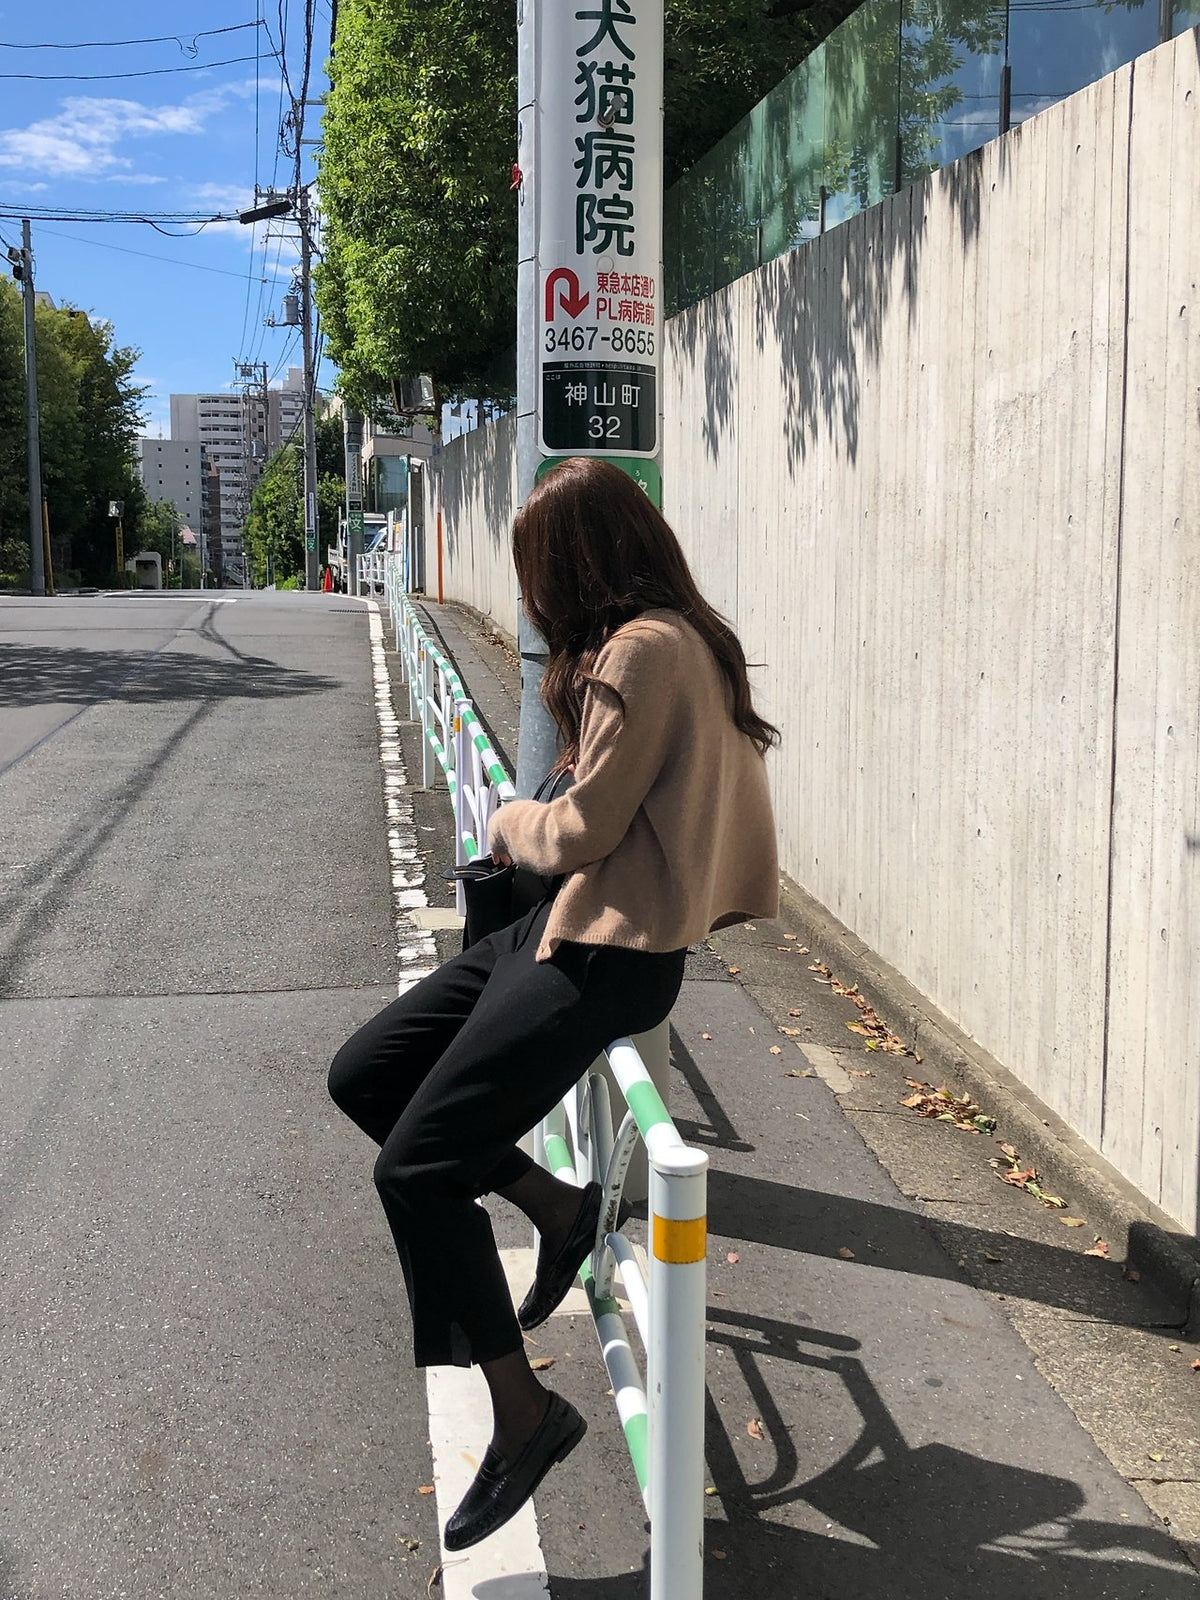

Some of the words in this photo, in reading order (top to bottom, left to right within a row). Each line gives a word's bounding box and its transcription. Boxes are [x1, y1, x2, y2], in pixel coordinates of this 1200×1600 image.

[574, 0, 636, 257] 犬猫病院
[596, 271, 655, 299] 東急本店通り
[596, 297, 655, 326] PL病院前
[545, 326, 655, 357] 3467-8655
[564, 381, 641, 408] 神山町
[588, 415, 621, 439] 32
